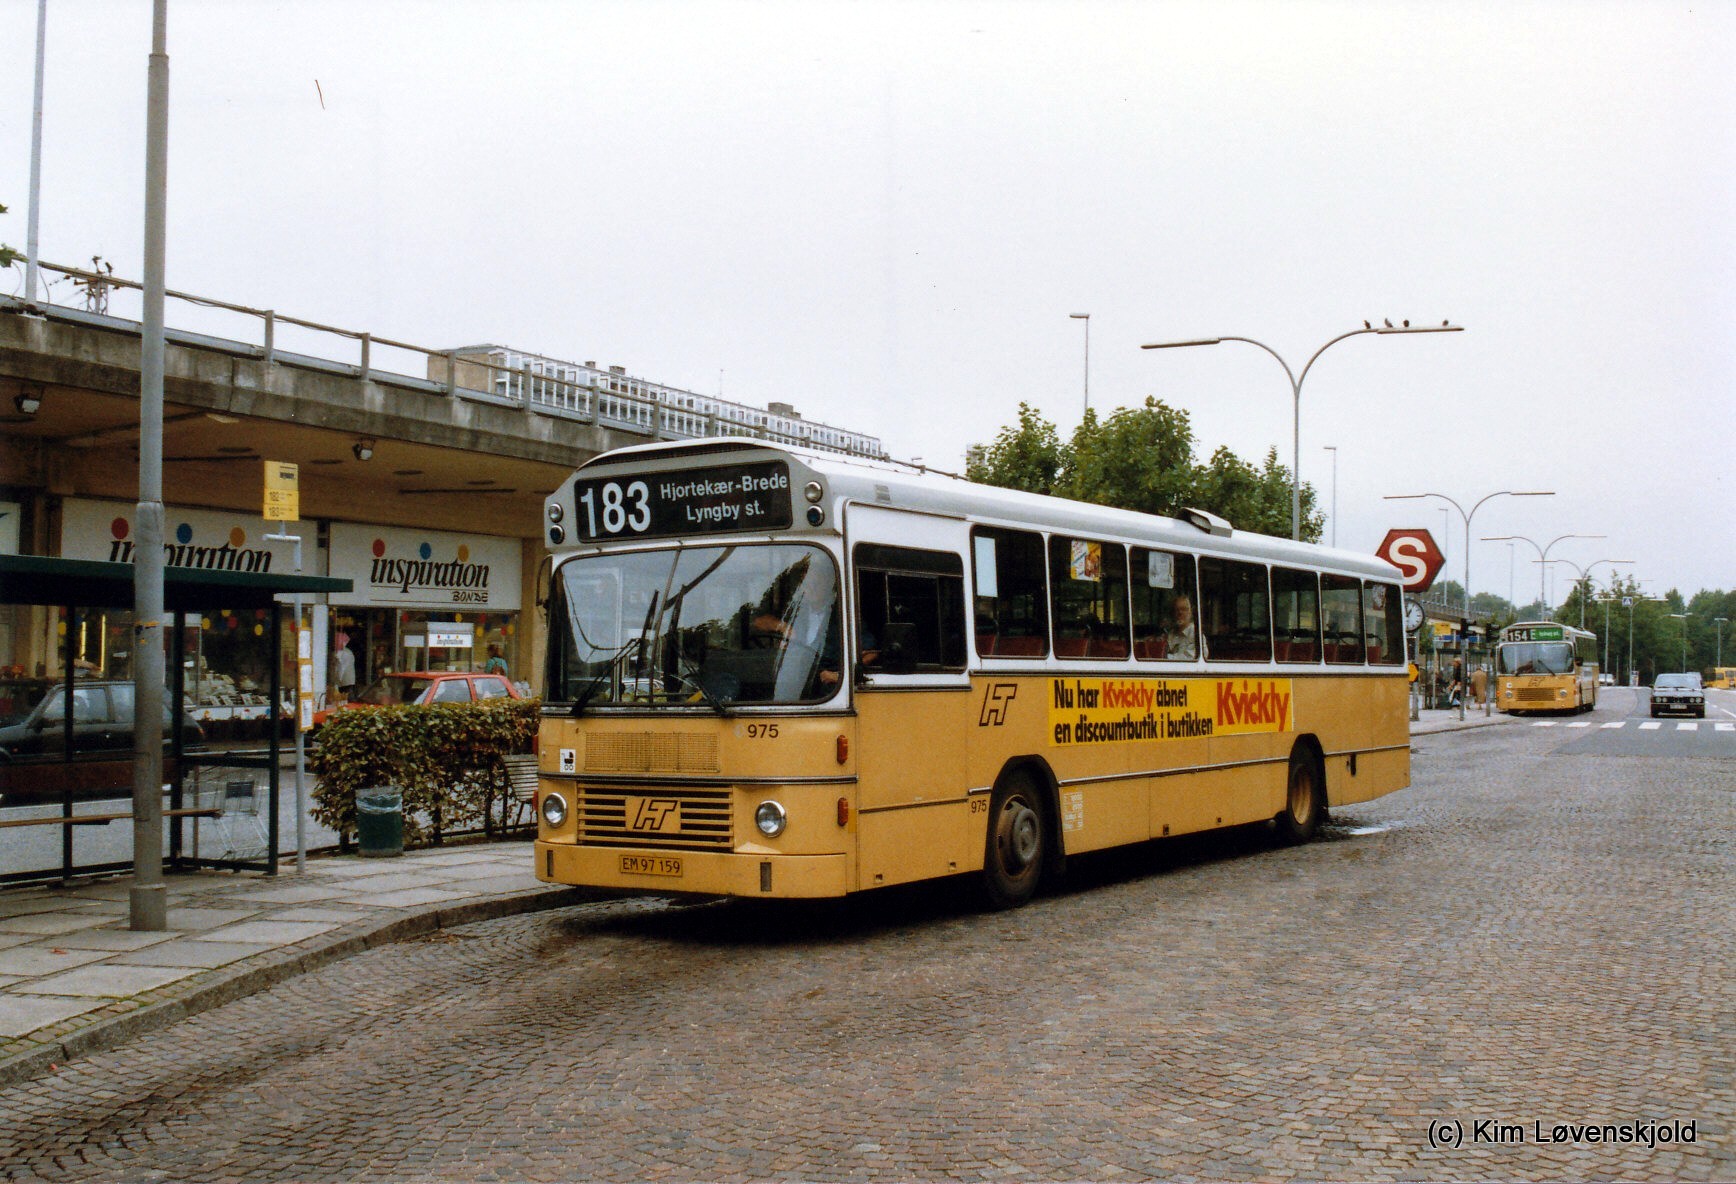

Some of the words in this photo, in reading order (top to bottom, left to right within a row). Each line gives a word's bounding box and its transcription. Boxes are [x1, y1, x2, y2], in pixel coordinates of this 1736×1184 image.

[660, 472, 788, 501] Hjortekær-Brede
[580, 481, 650, 538] 183
[686, 502, 740, 523] Lyngby
[745, 501, 765, 516] st.
[370, 539, 490, 593] inspiration
[1388, 536, 1428, 585] S
[452, 591, 489, 603] BONDE
[1508, 629, 1528, 642] 154
[1054, 680, 1074, 708] Nu
[1077, 680, 1100, 707] har
[1102, 681, 1155, 712] Kvickly
[1156, 682, 1188, 708] åbnet
[1216, 680, 1290, 732] Kvickly
[747, 724, 779, 739] 975
[1054, 723, 1071, 743] en
[1075, 713, 1158, 743] discountbutik
[1160, 716, 1165, 738] i
[1167, 715, 1213, 738] butikken
[971, 800, 987, 813] 975
[622, 857, 638, 870] EM
[640, 858, 655, 871] 97
[658, 860, 680, 873] 159
